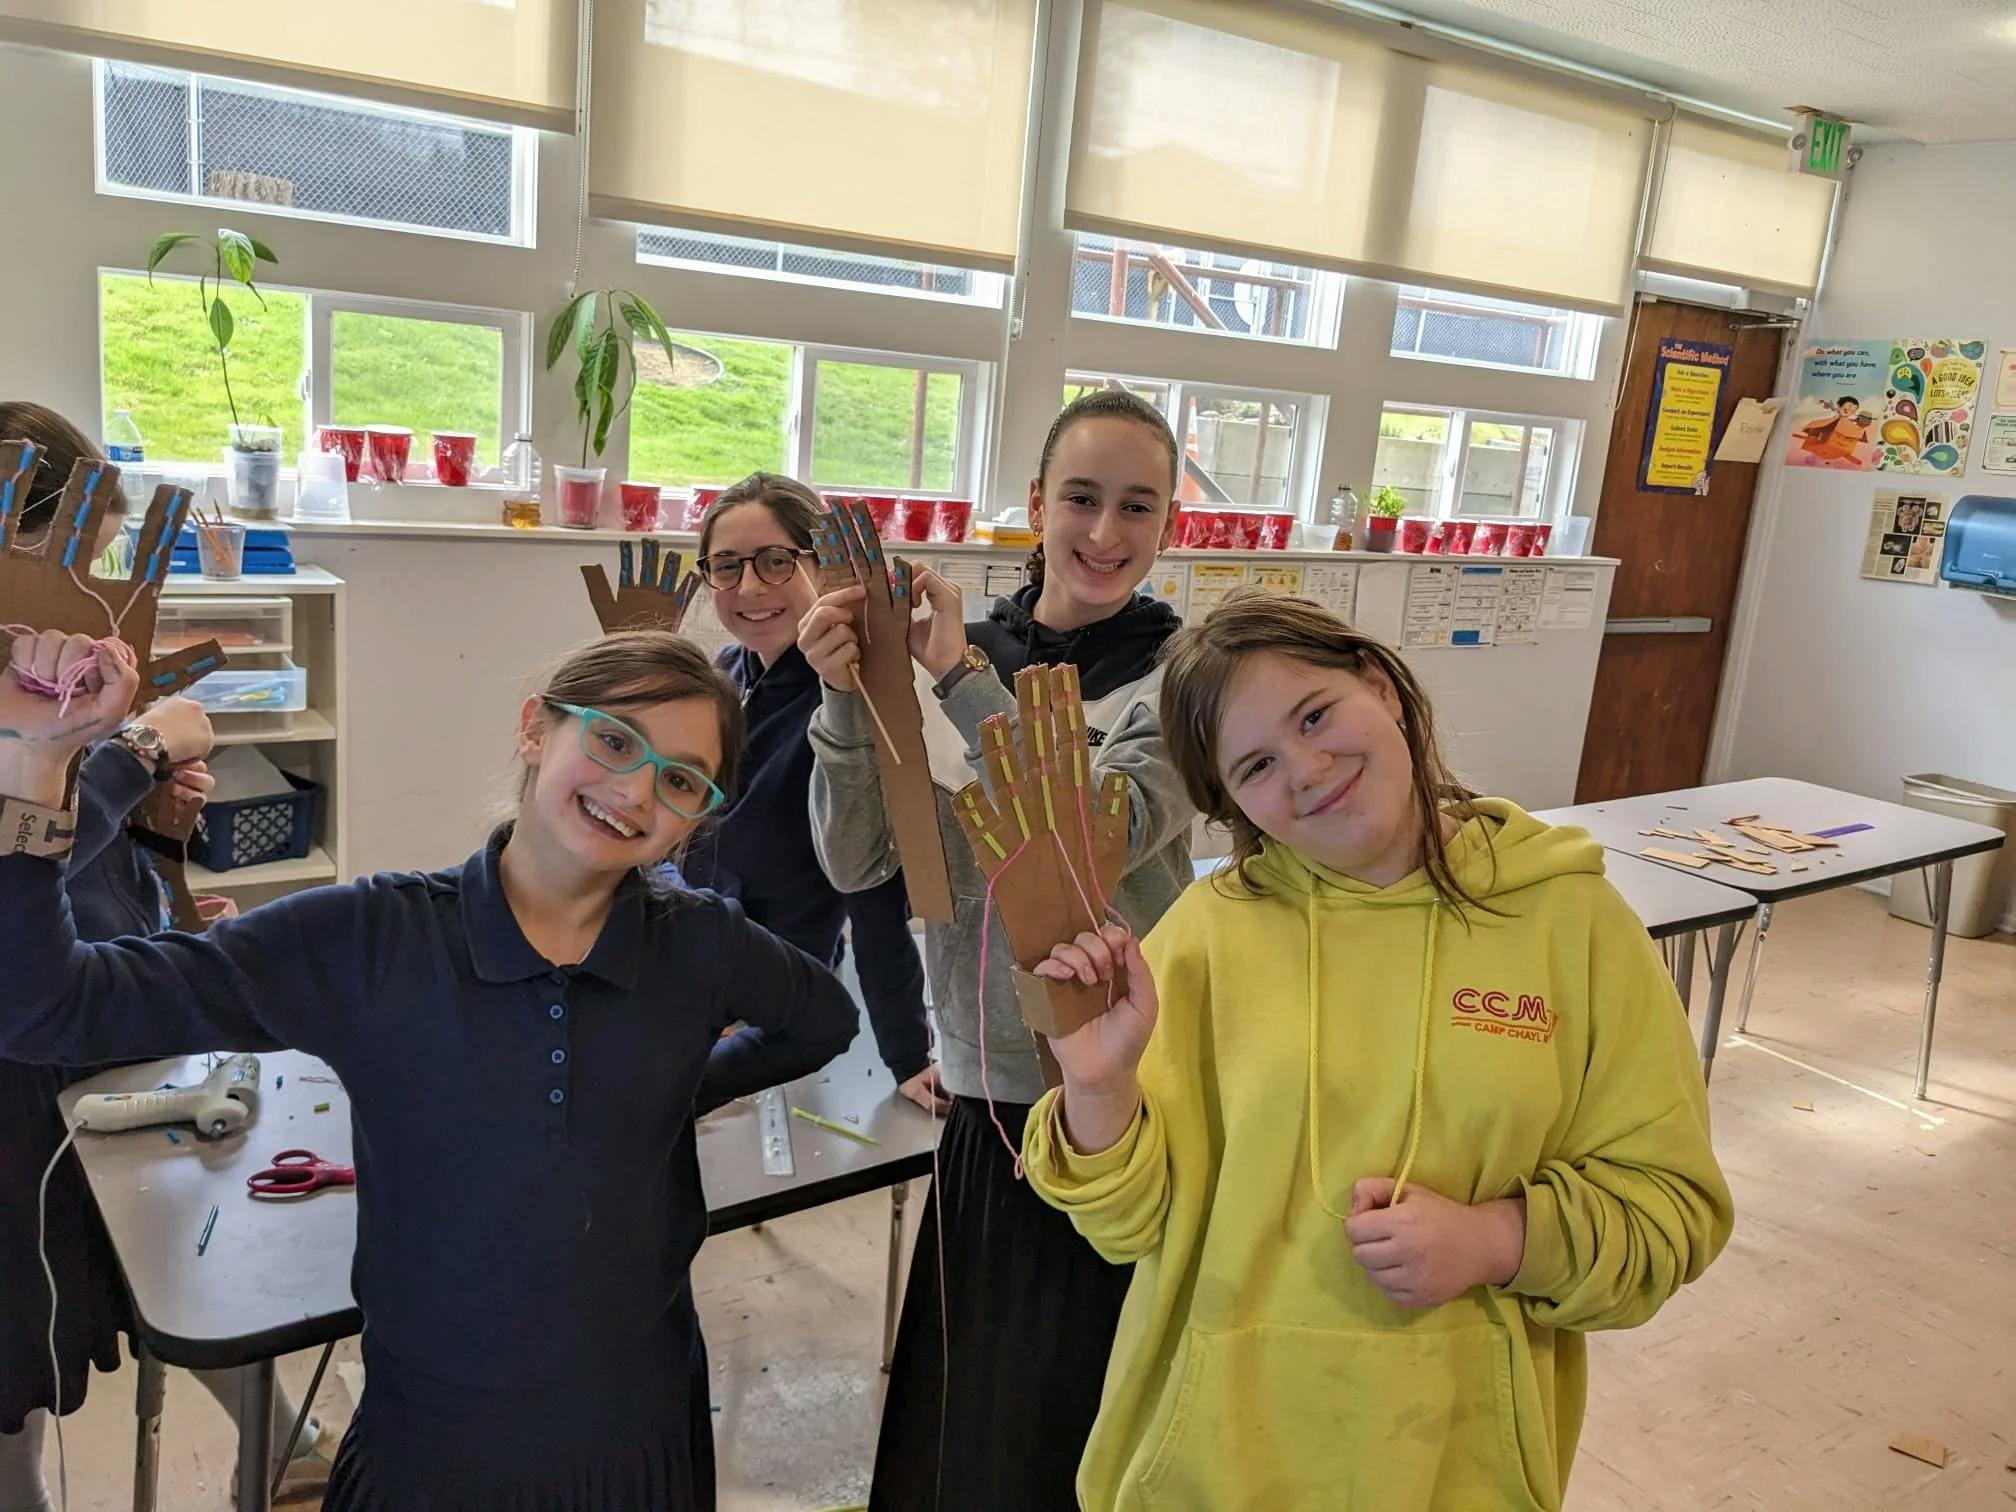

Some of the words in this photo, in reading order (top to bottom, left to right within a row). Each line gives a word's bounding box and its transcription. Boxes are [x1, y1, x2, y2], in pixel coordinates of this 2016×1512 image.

[1809, 118, 1846, 171] EXIT
[1660, 345, 1699, 362] Scientific
[1700, 351, 1730, 366] Method
[1938, 372, 1958, 382] GOOD
[1958, 373, 1976, 387] IDEA
[1930, 389, 1945, 398] LOTS
[1452, 987, 1548, 1025] CCM
[1474, 1022, 1505, 1035] CAMP
